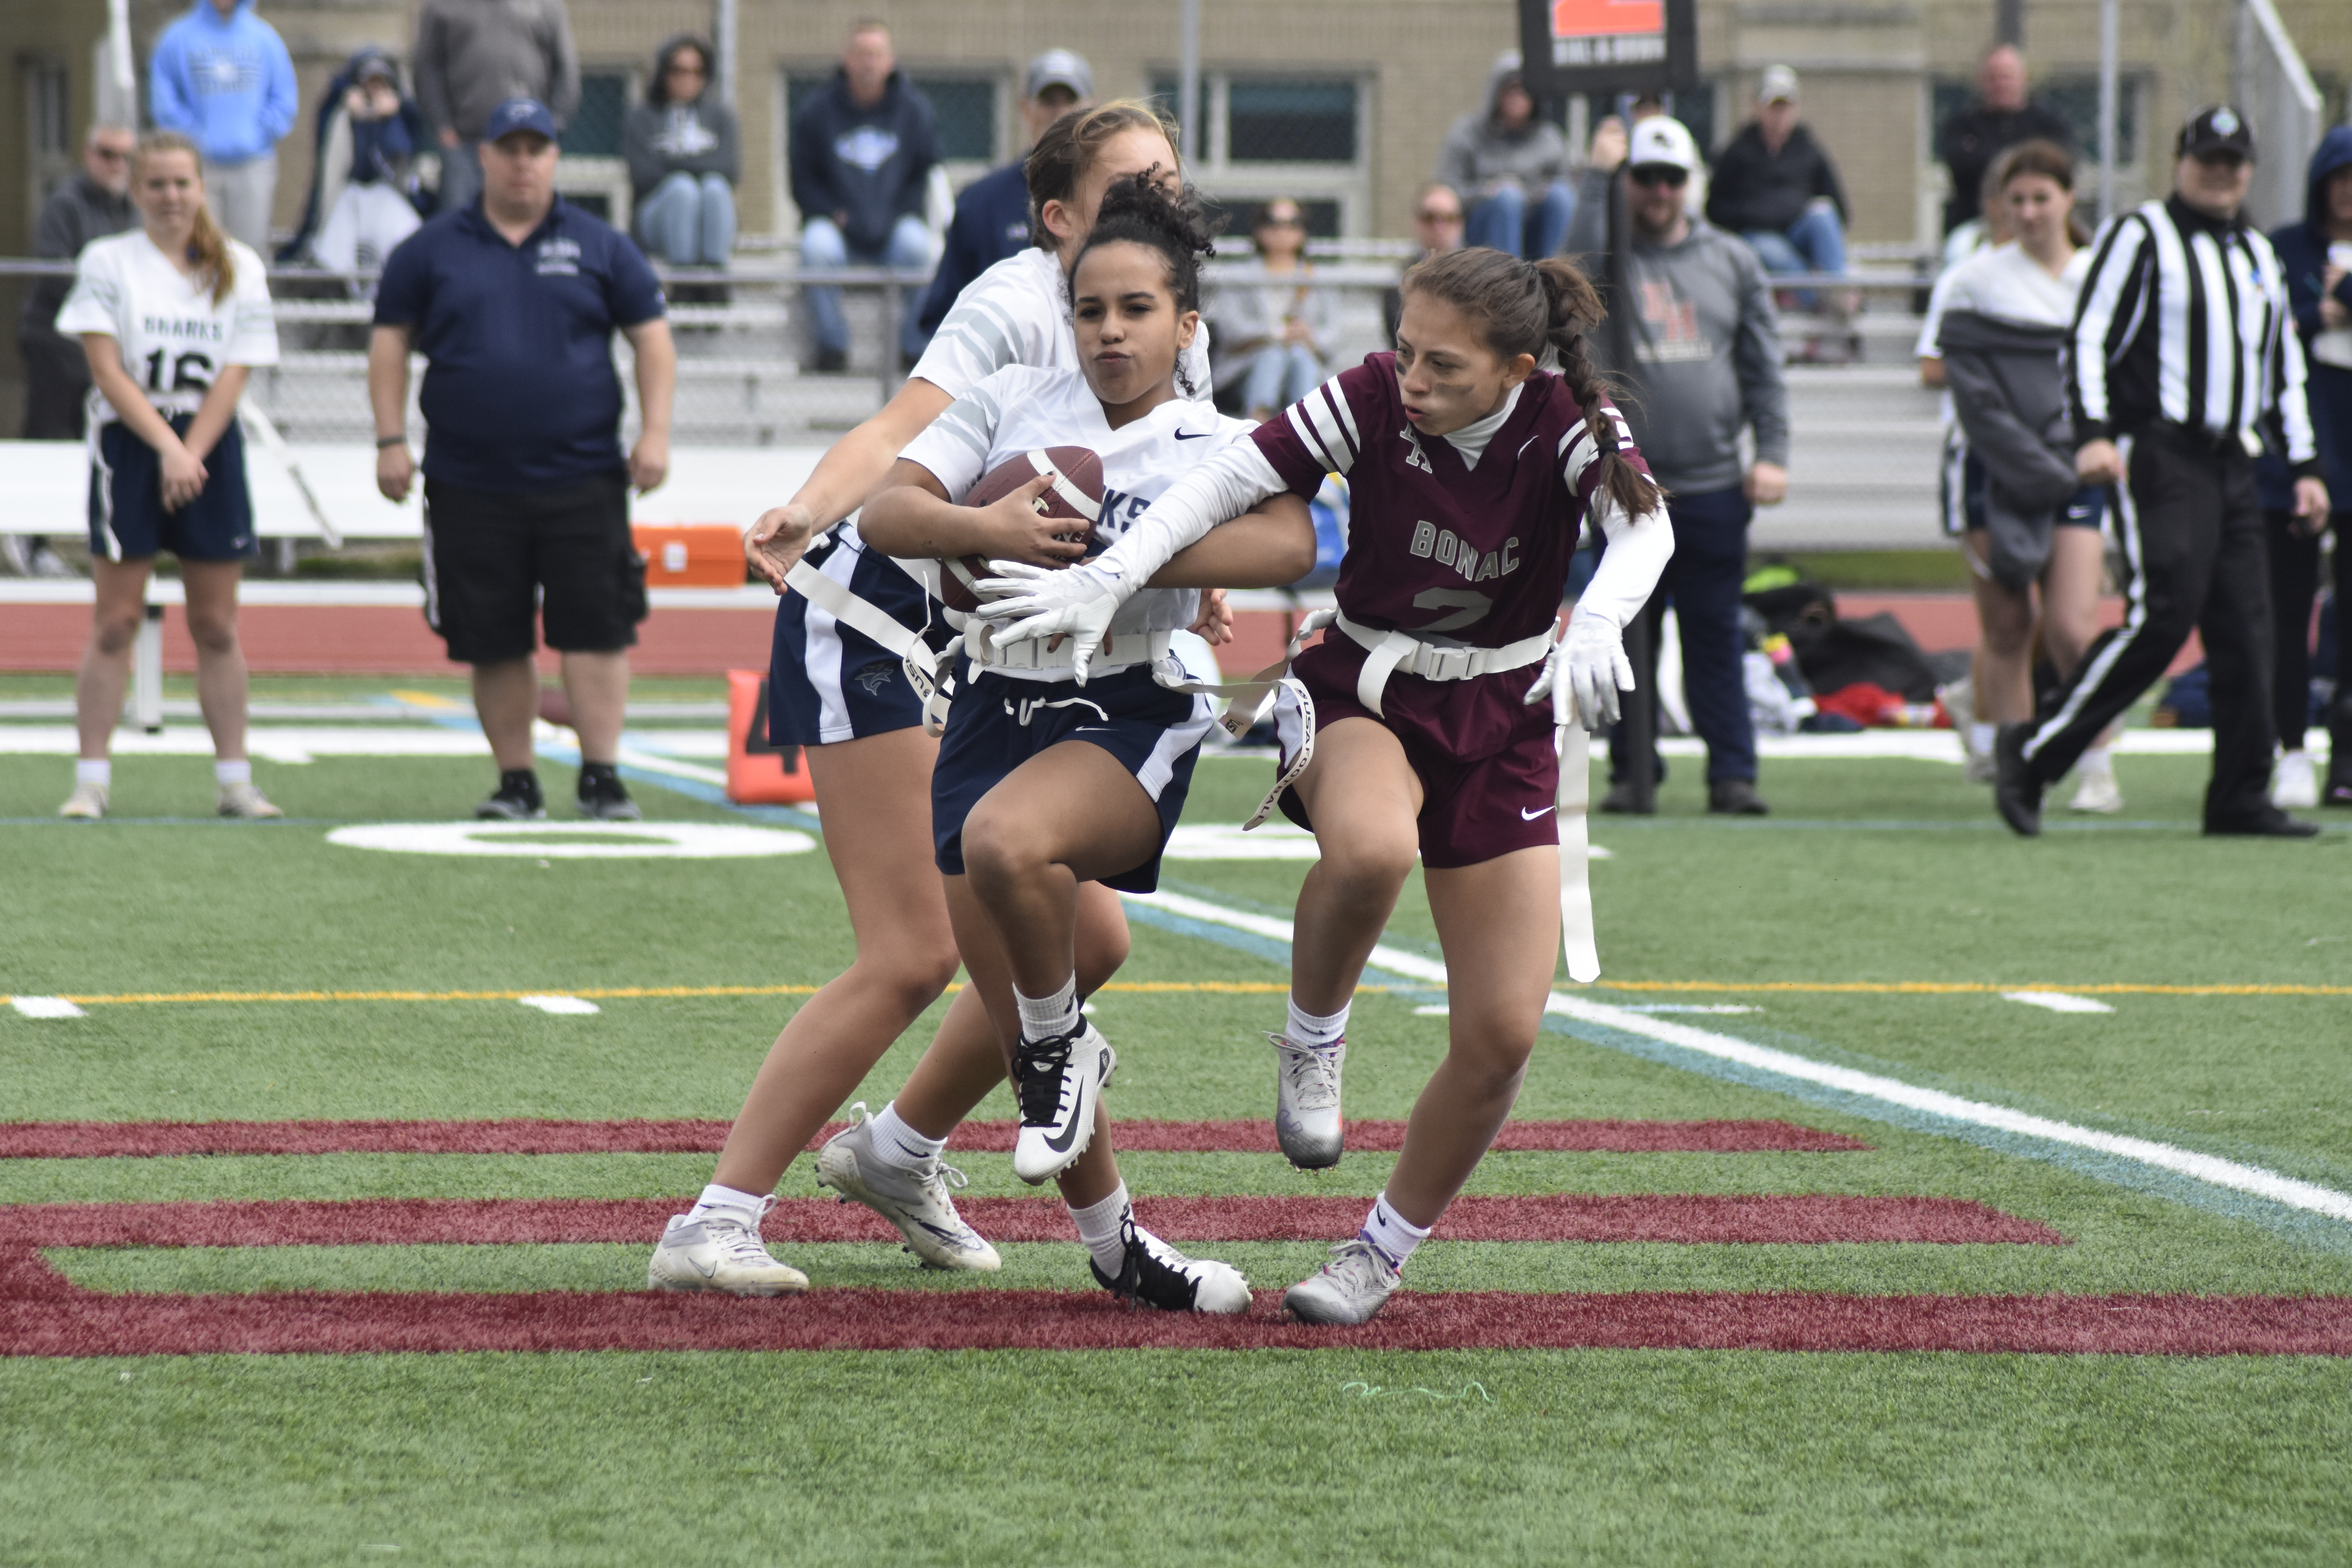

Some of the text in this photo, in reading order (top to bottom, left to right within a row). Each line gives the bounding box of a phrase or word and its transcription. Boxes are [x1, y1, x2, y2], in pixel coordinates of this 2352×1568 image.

[146, 347, 212, 392] 16
[1098, 485, 1151, 533] KS
[1410, 520, 1519, 582] BONAC
[1253, 701, 1311, 824] USA FOOTBALL
